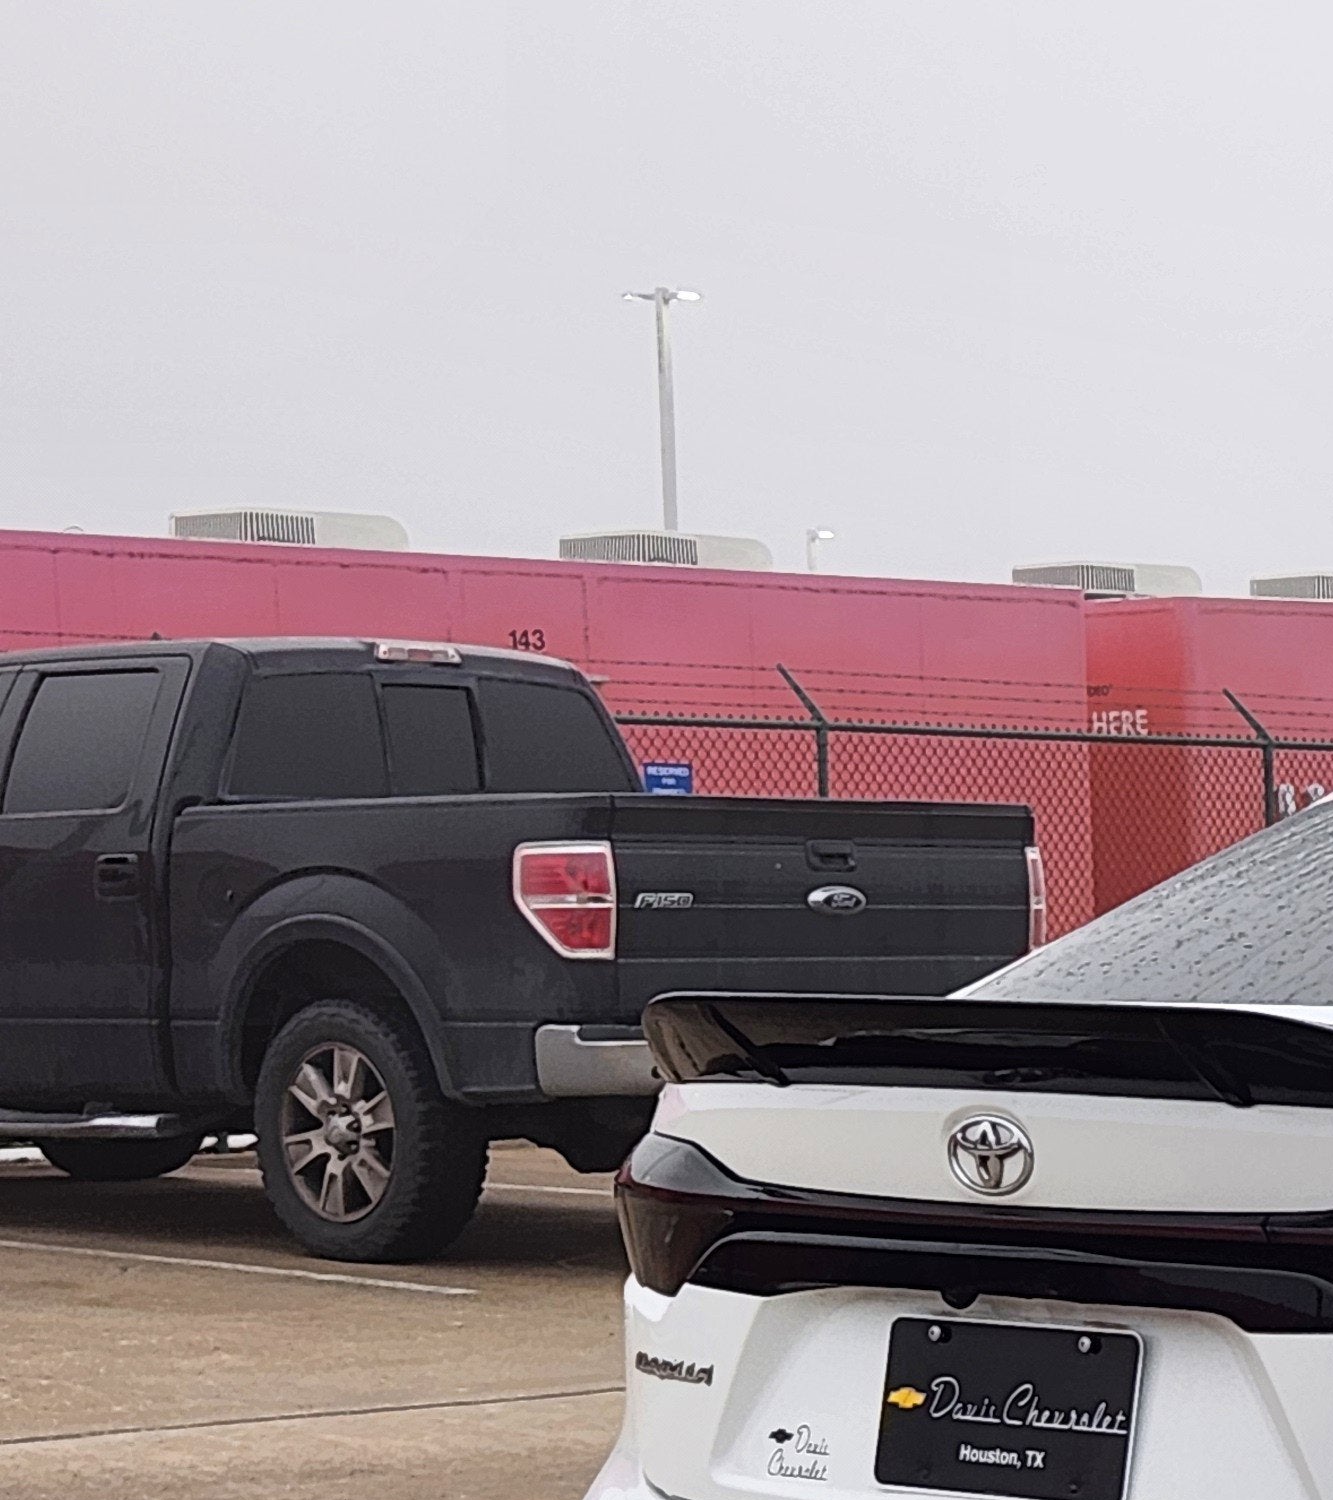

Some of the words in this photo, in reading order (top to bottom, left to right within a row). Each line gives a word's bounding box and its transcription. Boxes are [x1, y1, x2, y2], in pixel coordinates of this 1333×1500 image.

[508, 628, 546, 651] 143
[1092, 709, 1149, 736] HERE
[929, 1376, 1001, 1422] Davis
[1002, 1383, 1128, 1435] Chevrolet
[959, 1443, 1021, 1469] Houston,
[1025, 1450, 1046, 1468] TX
